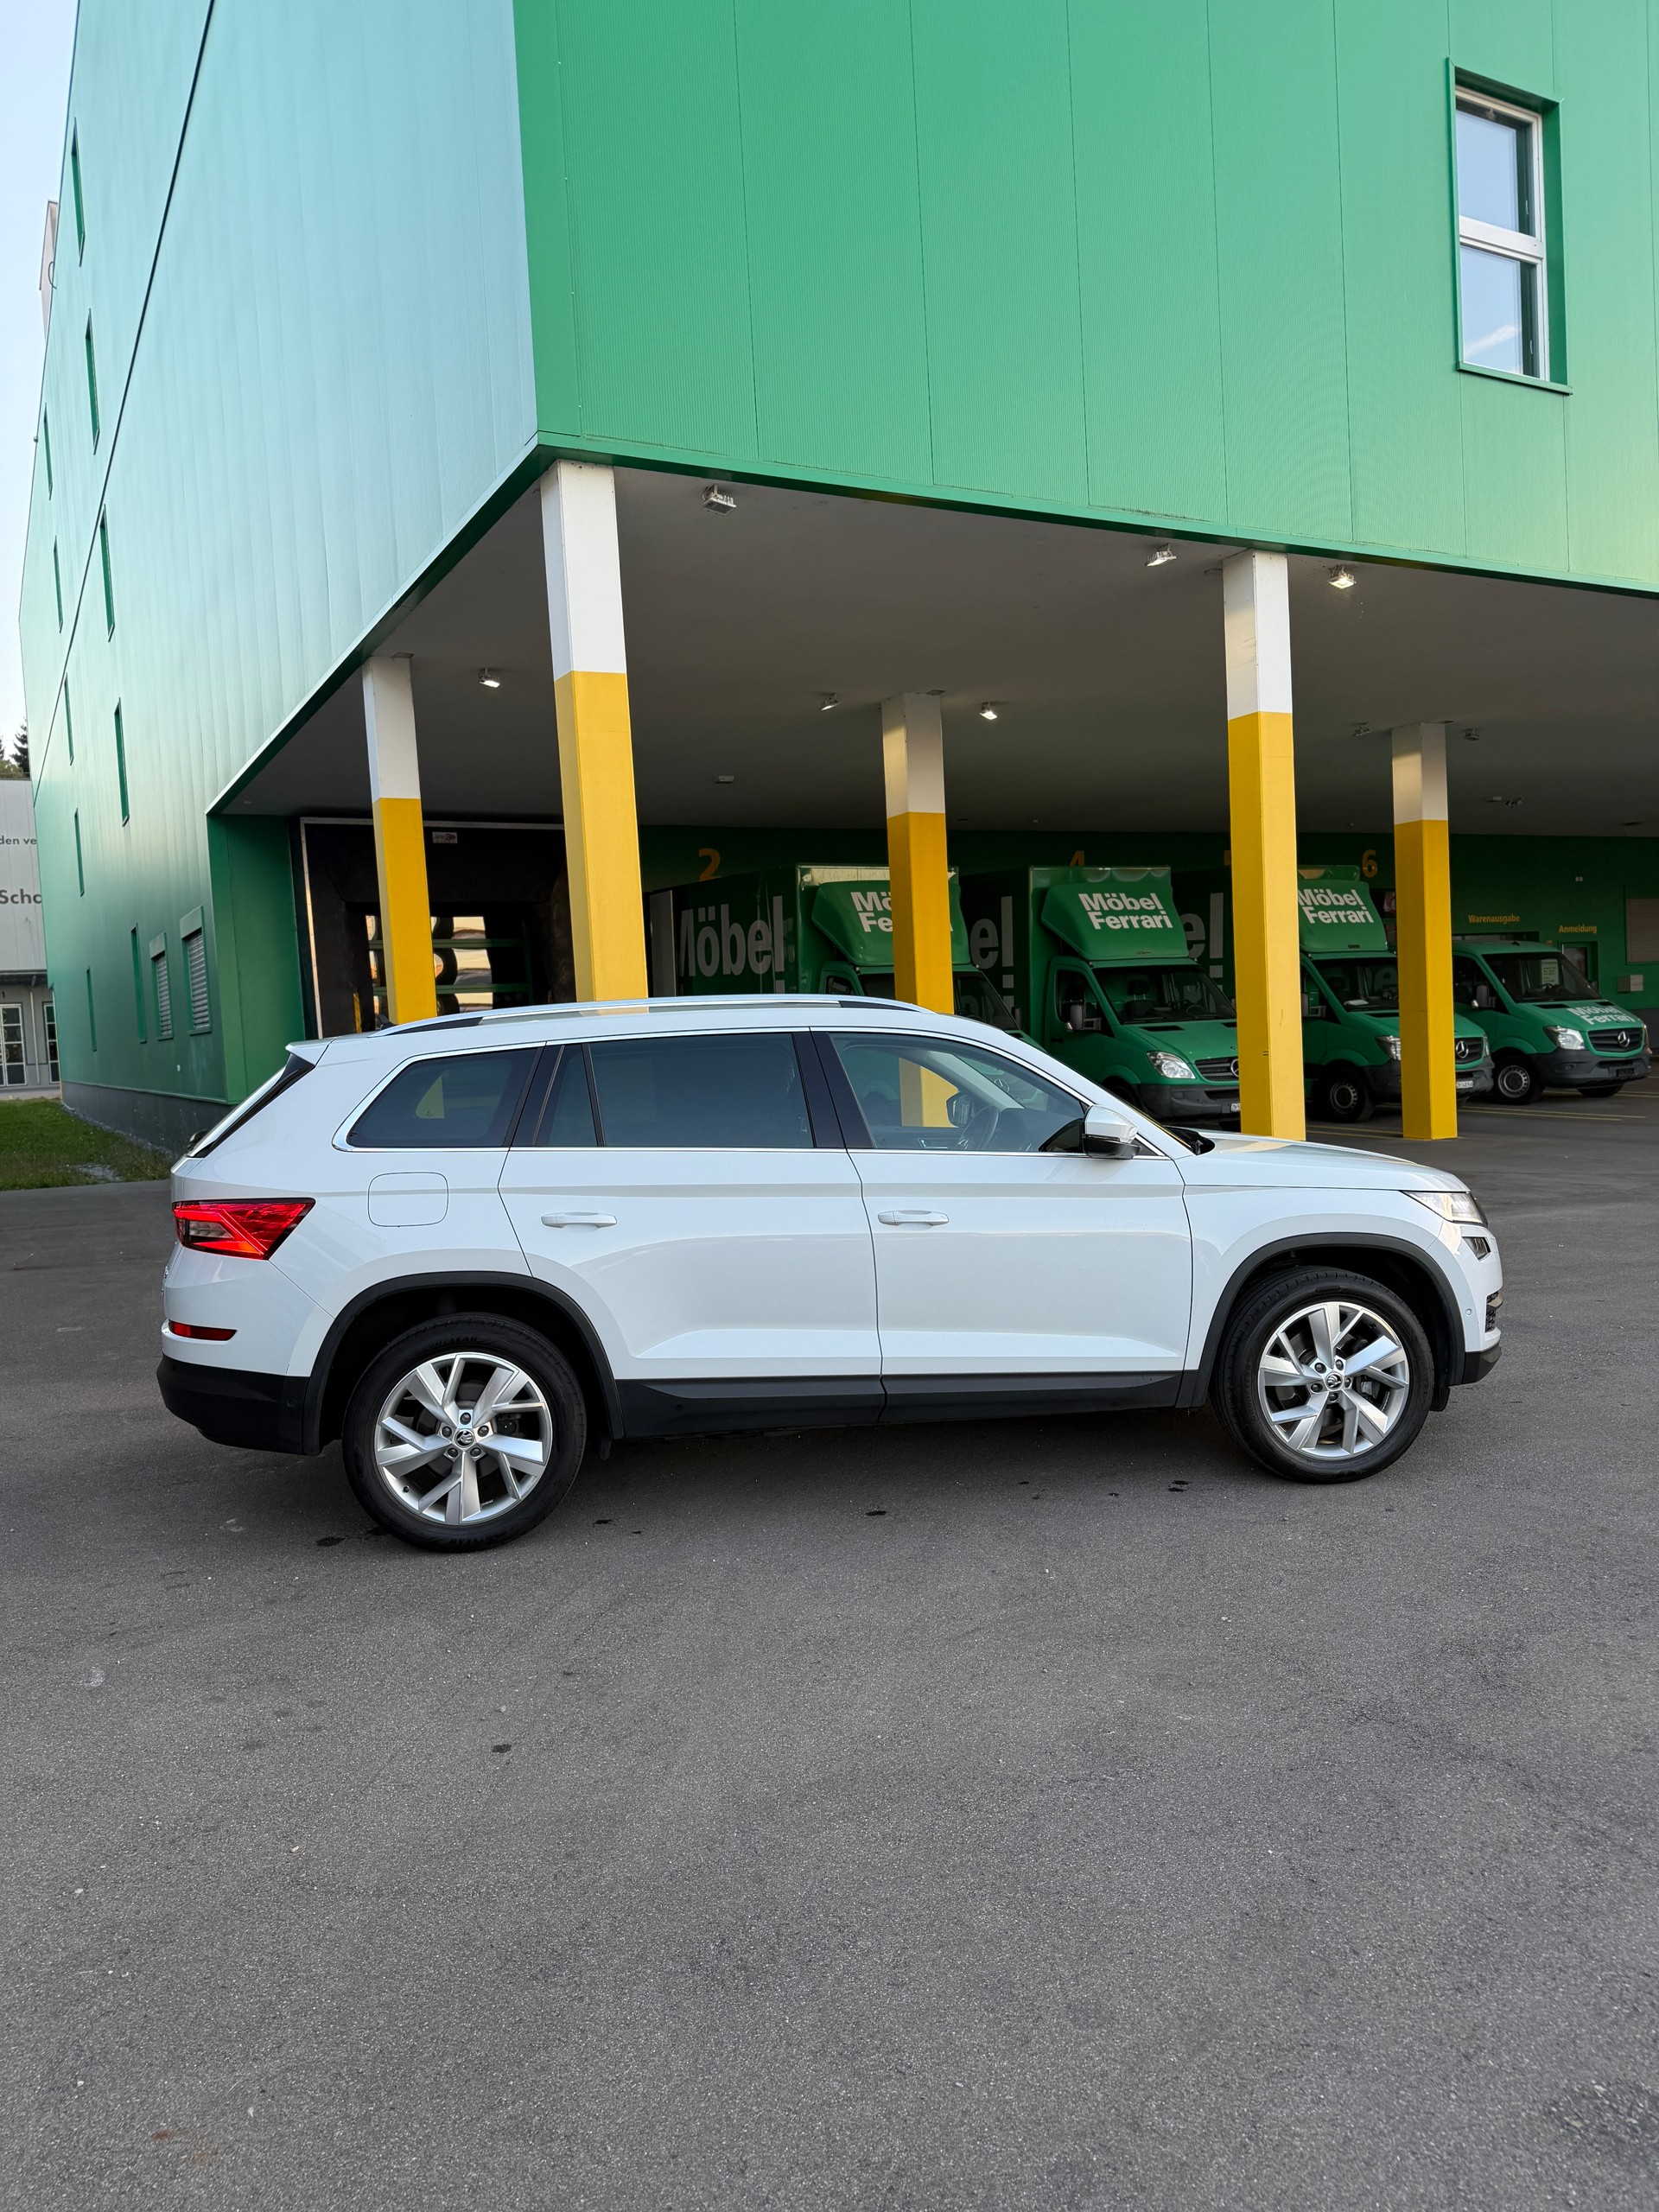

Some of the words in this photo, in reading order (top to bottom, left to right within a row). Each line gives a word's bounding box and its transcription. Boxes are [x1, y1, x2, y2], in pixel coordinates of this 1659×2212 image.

[698, 848, 721, 881] 2
[1363, 849, 1378, 879] 6
[1078, 893, 1164, 912] Möbel
[1298, 888, 1364, 906] Möbel
[1087, 910, 1173, 931] Ferrari
[1302, 906, 1374, 925] Ferrari
[1468, 913, 1521, 924] Warenausgabe
[1559, 924, 1598, 934] Anmeldung
[1567, 1006, 1622, 1016] Möbel
[1580, 1013, 1636, 1025] Ferrari
